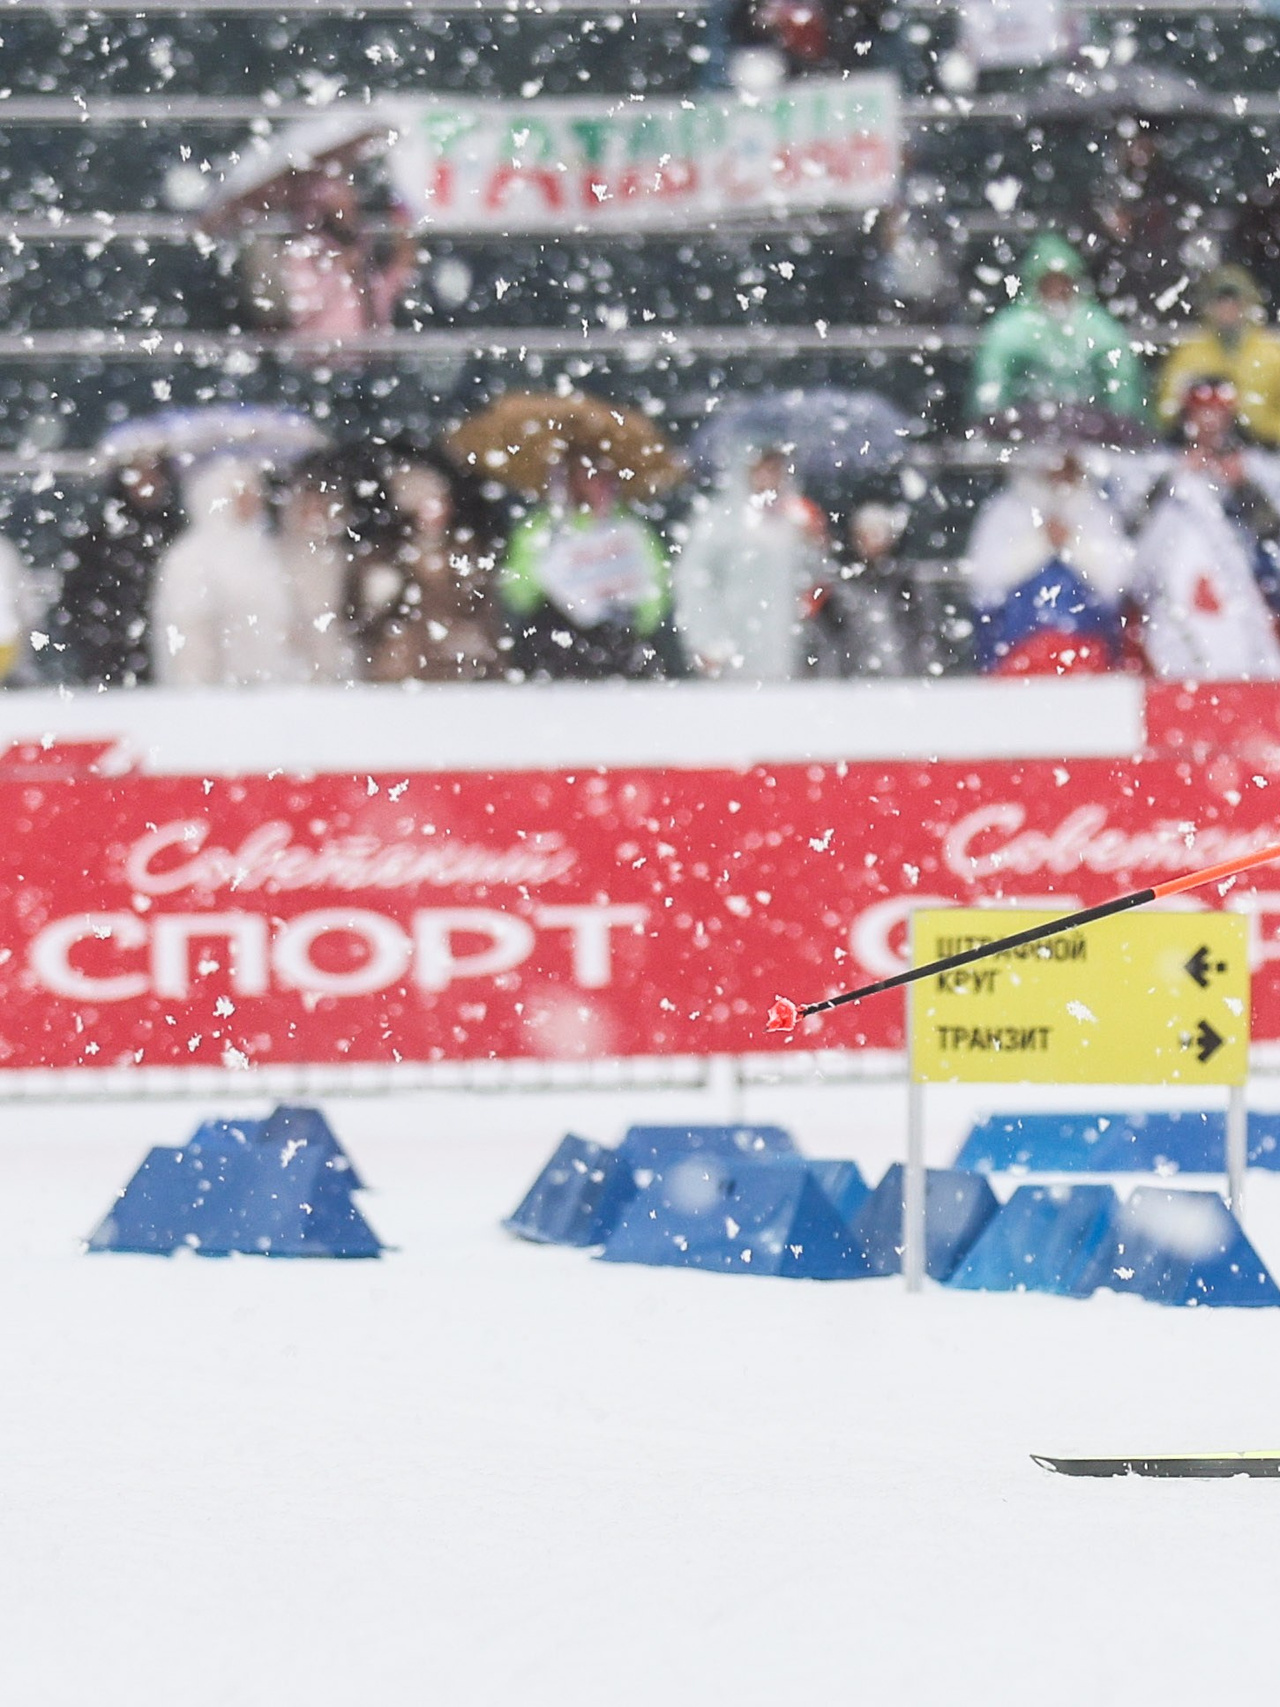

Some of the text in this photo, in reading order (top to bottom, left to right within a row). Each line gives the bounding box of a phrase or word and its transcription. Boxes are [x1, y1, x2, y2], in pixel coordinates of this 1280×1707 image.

[28, 906, 648, 1001] СПОРТ
[938, 968, 1000, 994] КРУГ
[938, 1026, 1052, 1050] ТРАНЗИТ
